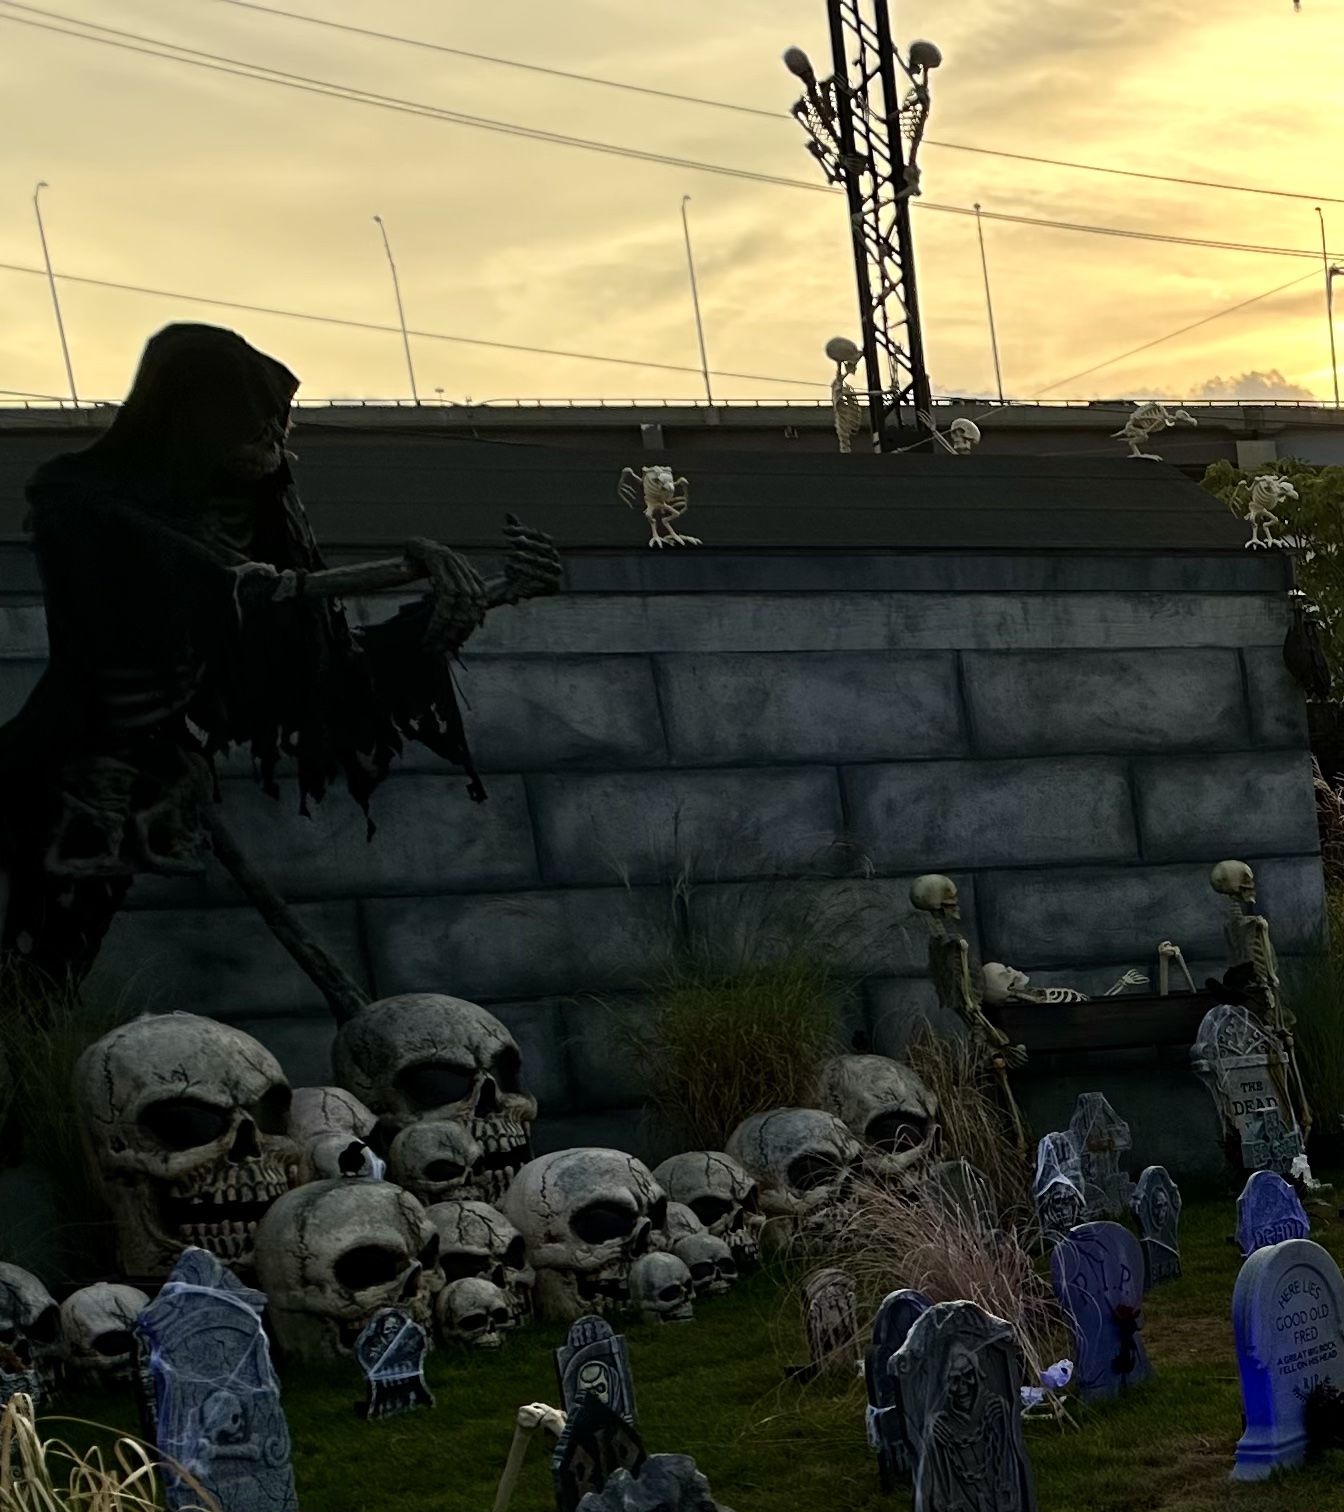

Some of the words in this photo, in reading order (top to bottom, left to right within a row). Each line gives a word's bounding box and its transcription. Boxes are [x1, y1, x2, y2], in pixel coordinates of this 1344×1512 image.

[1240, 1081, 1263, 1093] THE
[1231, 1097, 1278, 1116] DEAD
[1278, 1280, 1301, 1310] HERE
[1302, 1279, 1322, 1300] LIES
[1275, 1310, 1308, 1332] GOOD
[1309, 1303, 1329, 1321] OLD
[571, 1319, 612, 1347] RIP
[1294, 1326, 1319, 1345] FRED
[1284, 1349, 1307, 1364] GREAT
[1319, 1341, 1337, 1352] ROCK
[1297, 1360, 1308, 1370] ON
[1319, 1349, 1338, 1362] HEAD
